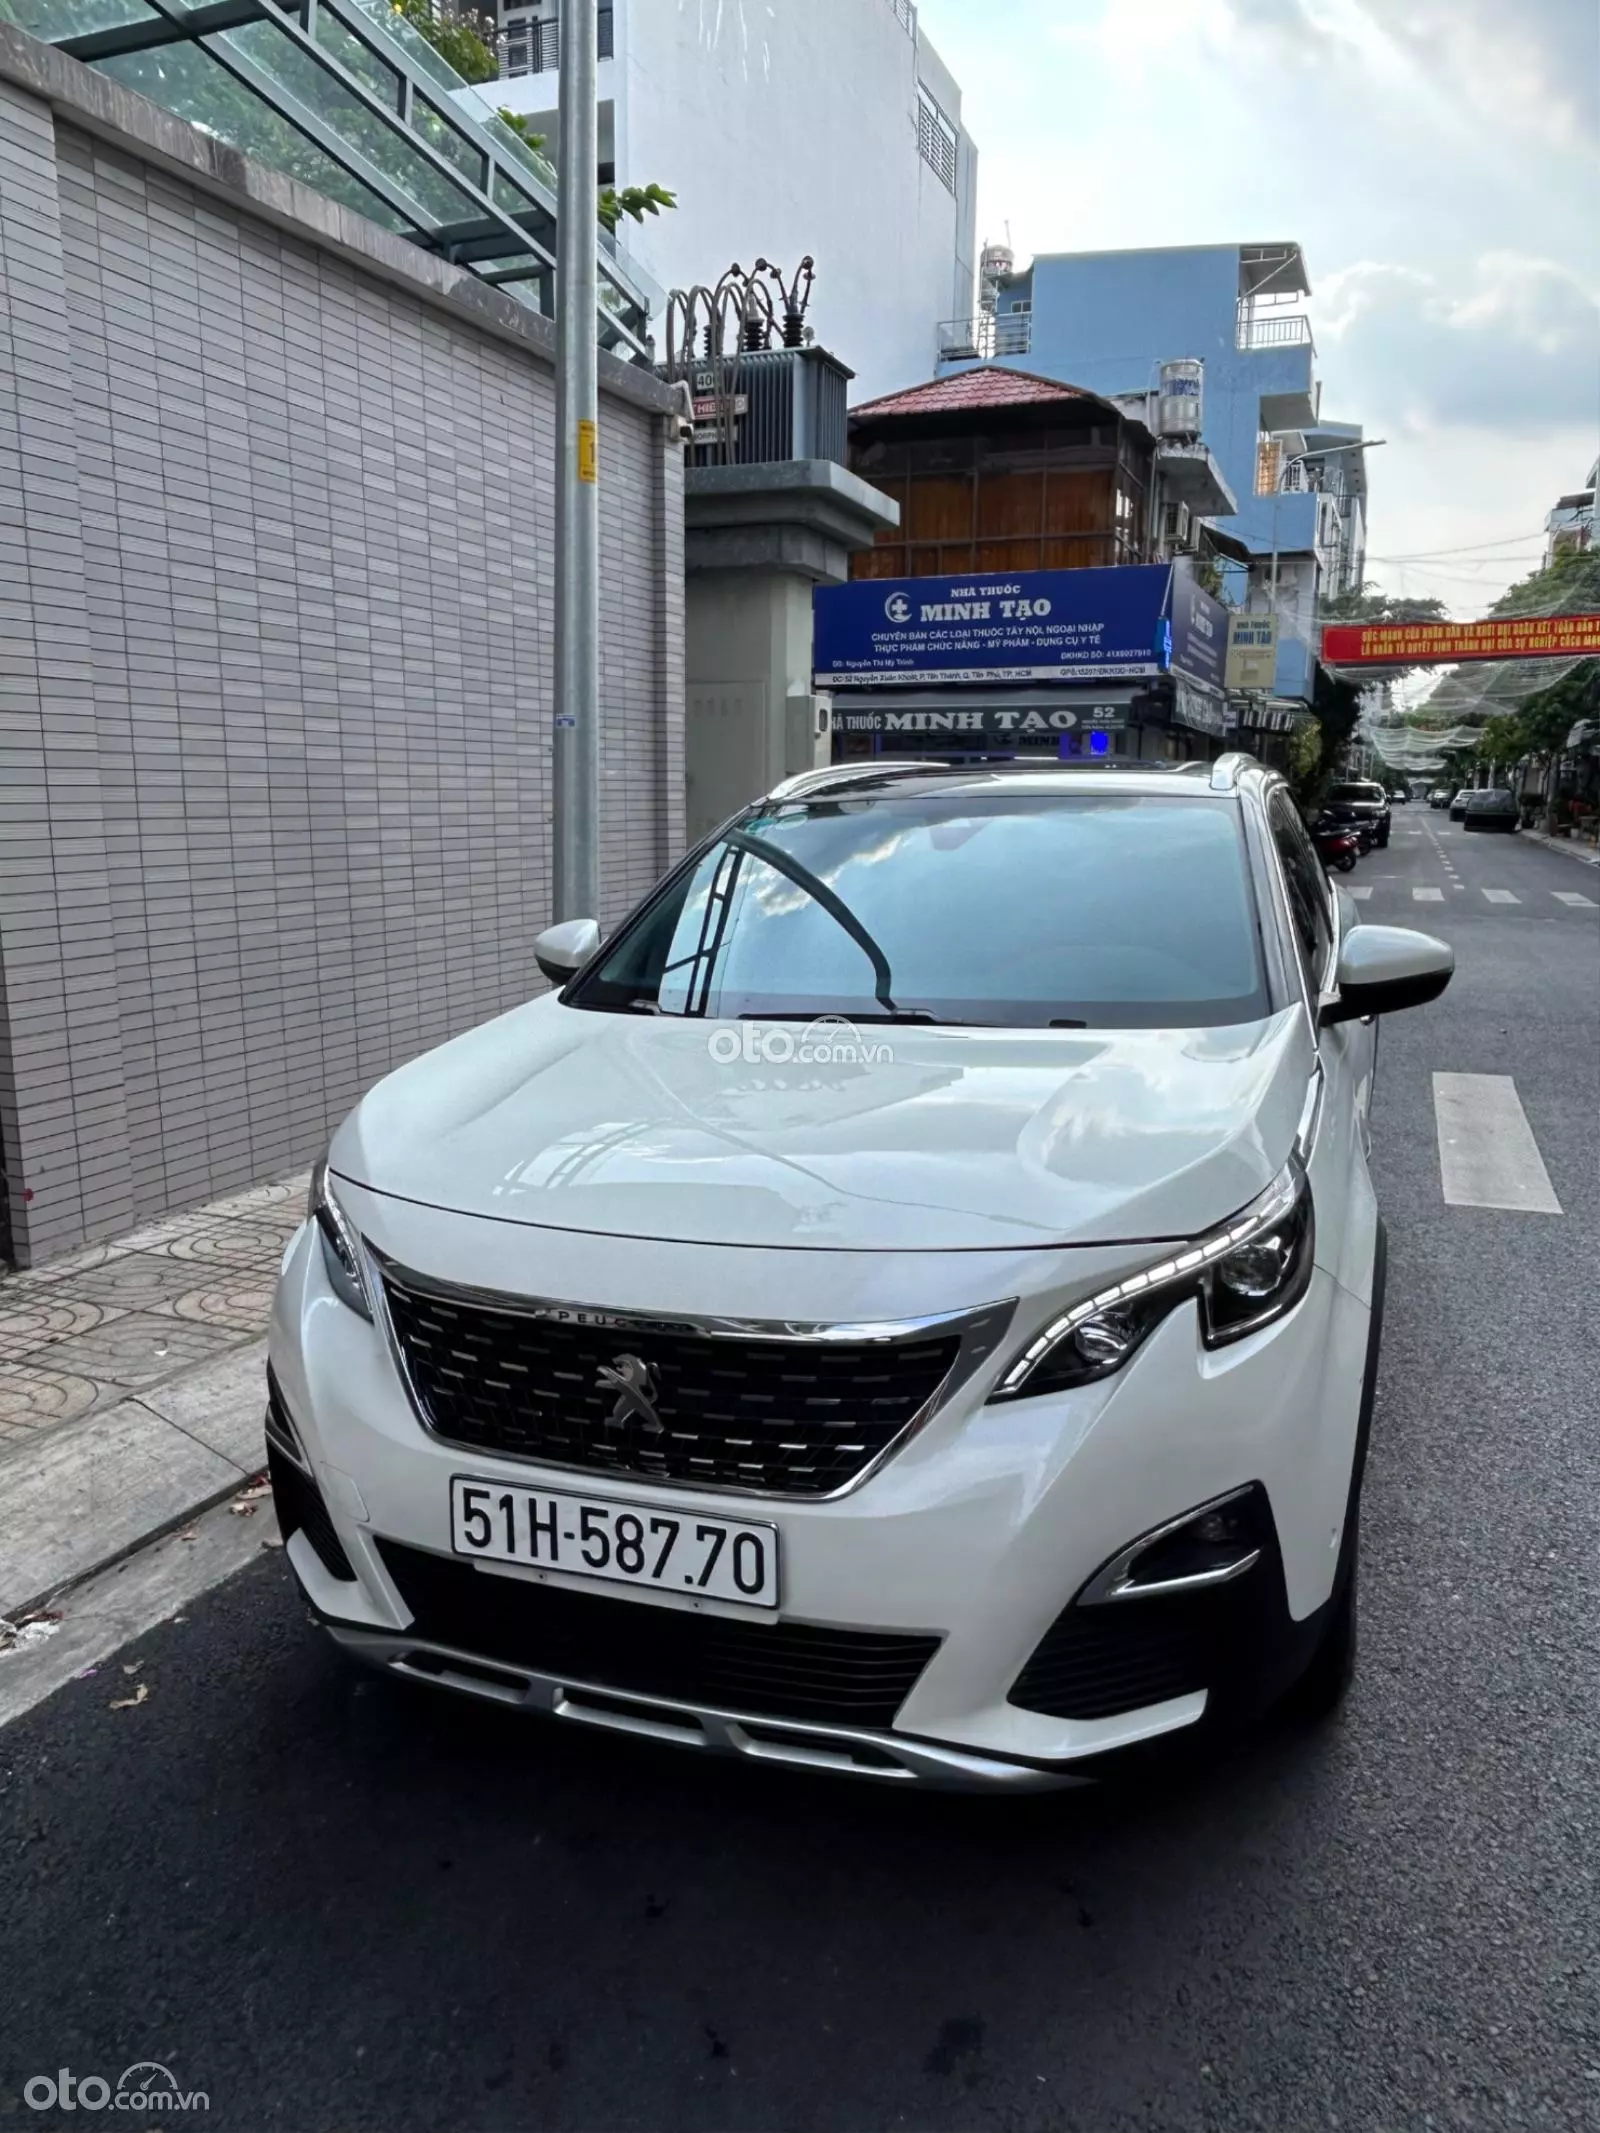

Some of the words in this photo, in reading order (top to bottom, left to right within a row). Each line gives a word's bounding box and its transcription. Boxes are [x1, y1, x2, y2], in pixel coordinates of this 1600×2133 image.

[920, 601, 991, 622] MINH
[1000, 598, 1051, 621] TẠO
[871, 630, 908, 642] CHUYÊN
[929, 627, 948, 639] CÁC
[950, 626, 971, 639] LOẠI
[1006, 624, 1023, 636] TÂY
[1046, 623, 1076, 635] NGOẠI
[874, 643, 898, 654] THỰC
[927, 640, 953, 651] CHỨC
[1036, 636, 1063, 648] DỤNG
[1064, 635, 1078, 647] CỤ
[1080, 635, 1088, 645] Y
[1088, 633, 1101, 645] TẾ
[846, 711, 882, 730] THUỐC
[884, 711, 984, 731] MINH
[994, 710, 1077, 733] TẠO
[1093, 706, 1116, 718] 52
[462, 1487, 766, 1595] 51H-587.70
